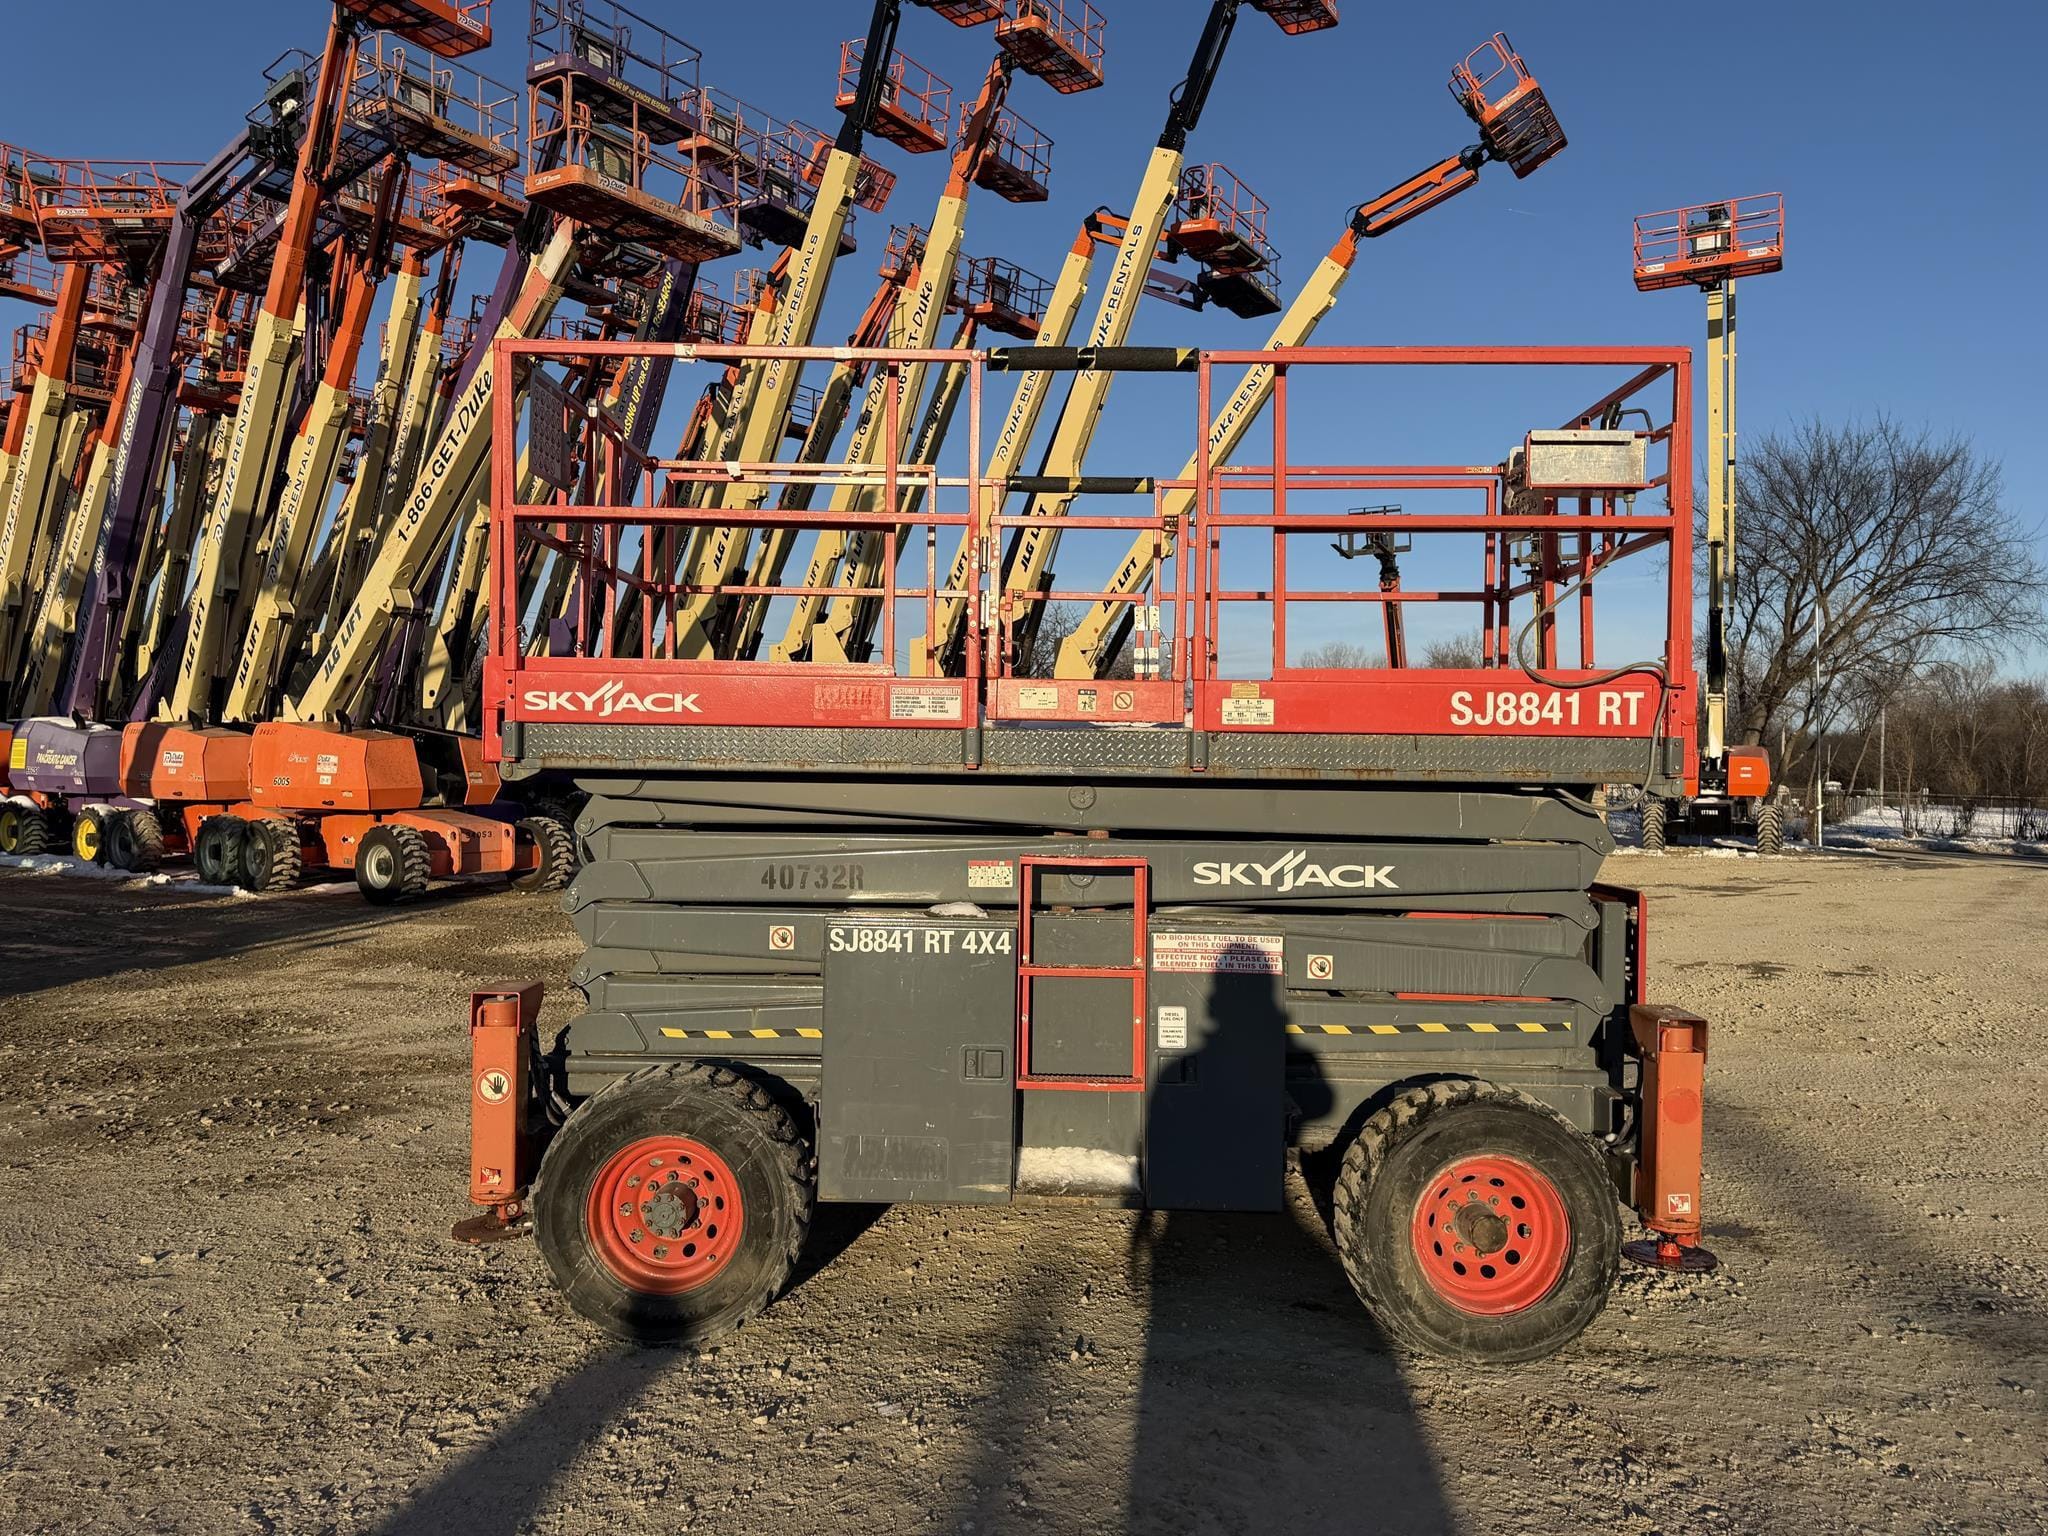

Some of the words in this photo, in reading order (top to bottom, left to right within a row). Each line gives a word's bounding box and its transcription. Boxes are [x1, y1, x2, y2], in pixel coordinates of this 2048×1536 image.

[792, 233, 819, 312] RENTALS
[1109, 224, 1143, 310] RENTALS
[1704, 255, 1721, 263] LIFT
[632, 385, 642, 405] UP
[652, 271, 675, 330] RESEARCH
[777, 312, 794, 347] uke
[1094, 312, 1112, 348] uke
[1020, 331, 1051, 404] RENS
[1232, 340, 1284, 413] RENTAS
[232, 364, 260, 463] RENTALS
[1003, 403, 1024, 446] Duke
[1208, 412, 1235, 455] Duke
[110, 443, 129, 498] CANCER
[123, 377, 144, 446] RESEARCH
[396, 369, 493, 543] 1-866-GET-Duke
[12, 424, 34, 506] RENTALS
[288, 433, 316, 515] RENTALS
[72, 483, 94, 551] RENTALS
[218, 465, 236, 528] Duke
[711, 541, 726, 574] JLG
[807, 560, 820, 588] LIFT
[846, 562, 858, 588] JLG
[853, 530, 867, 559] LIF
[953, 550, 968, 582] LIFT
[1020, 541, 1035, 574] JLG
[1117, 556, 1139, 588] LIFT
[184, 642, 197, 679] JLG
[192, 597, 206, 642] LIFT
[239, 659, 251, 690] JLG
[246, 620, 261, 659] LIFT
[322, 644, 341, 684] JLG
[340, 602, 363, 649] LIFT
[523, 679, 704, 717] SKYJACK
[891, 687, 920, 695] CUSTOMER
[920, 687, 961, 696] RESPONSIBILITY
[1450, 691, 1580, 726] SJ8841
[1598, 691, 1645, 727] RT
[273, 775, 291, 786] 600S
[761, 863, 865, 890] 40732R
[1192, 849, 1400, 892] SKYJACK
[829, 929, 914, 954] SJ8841
[924, 930, 954, 954] RT
[961, 931, 1012, 955] 4X4
[1155, 953, 1198, 961] EFFECTIVE
[1230, 955, 1262, 963] PLEASE
[1263, 956, 1281, 964] USE
[1213, 935, 1233, 943] FUEL
[1260, 936, 1281, 944] USED
[1237, 962, 1257, 970] THIS
